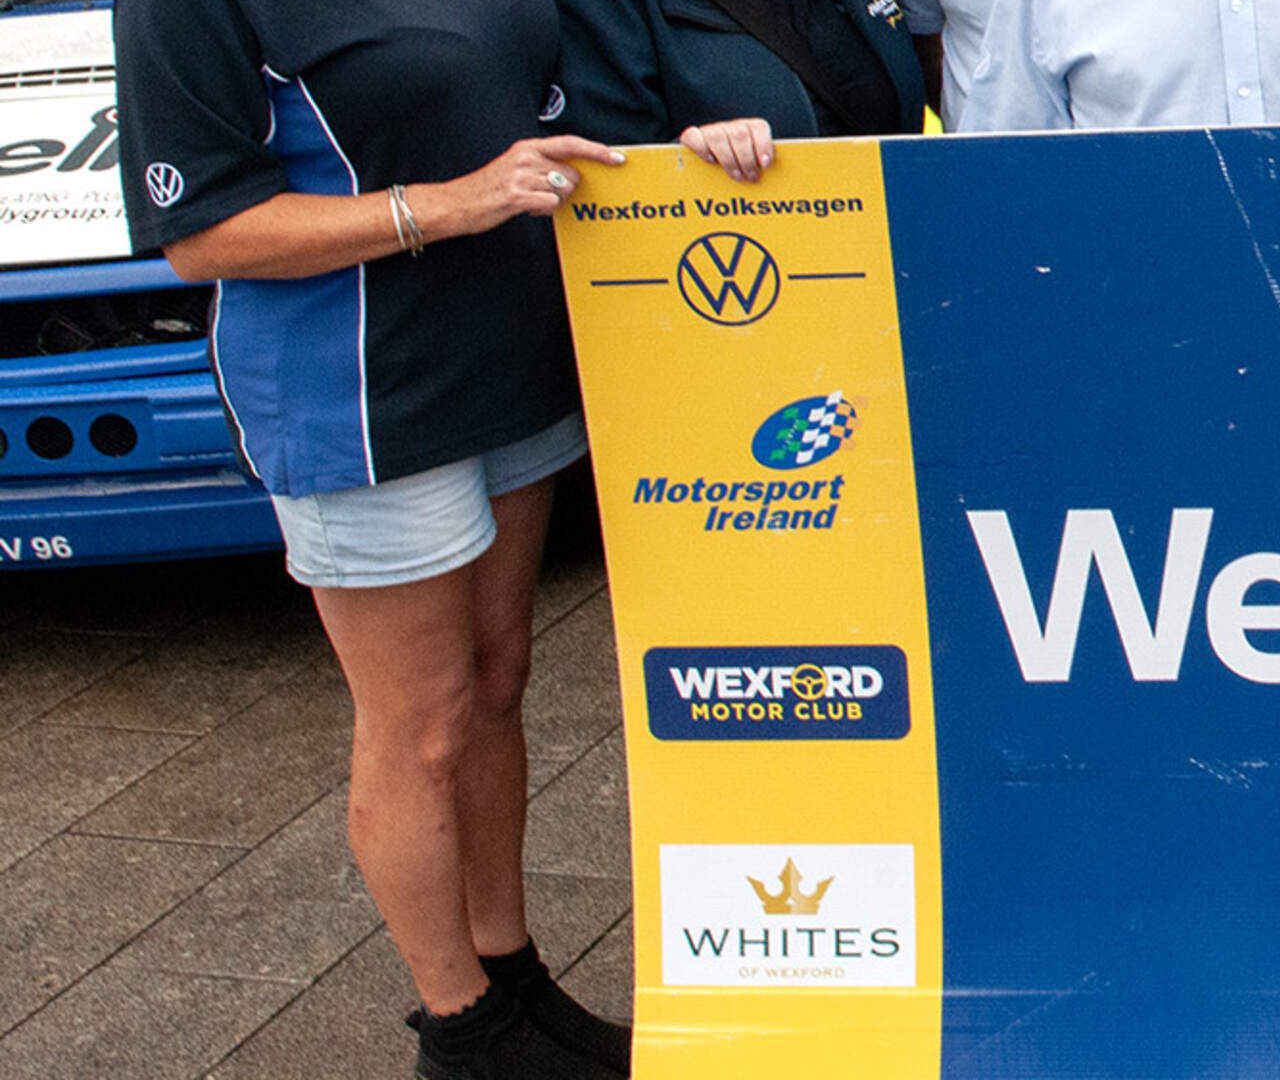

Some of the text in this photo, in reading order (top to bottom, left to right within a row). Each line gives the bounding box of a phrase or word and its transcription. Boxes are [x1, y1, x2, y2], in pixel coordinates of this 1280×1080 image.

[572, 196, 864, 221] Wexford Volkswagen
[633, 474, 845, 507] Motorsport
[704, 504, 839, 531] Ireland
[30, 535, 73, 559] 96
[669, 664, 884, 700] WEXFORD
[690, 702, 863, 721] MOTOR CLUB
[682, 927, 901, 958] WHITES
[738, 967, 846, 979] OF WEXFORD
